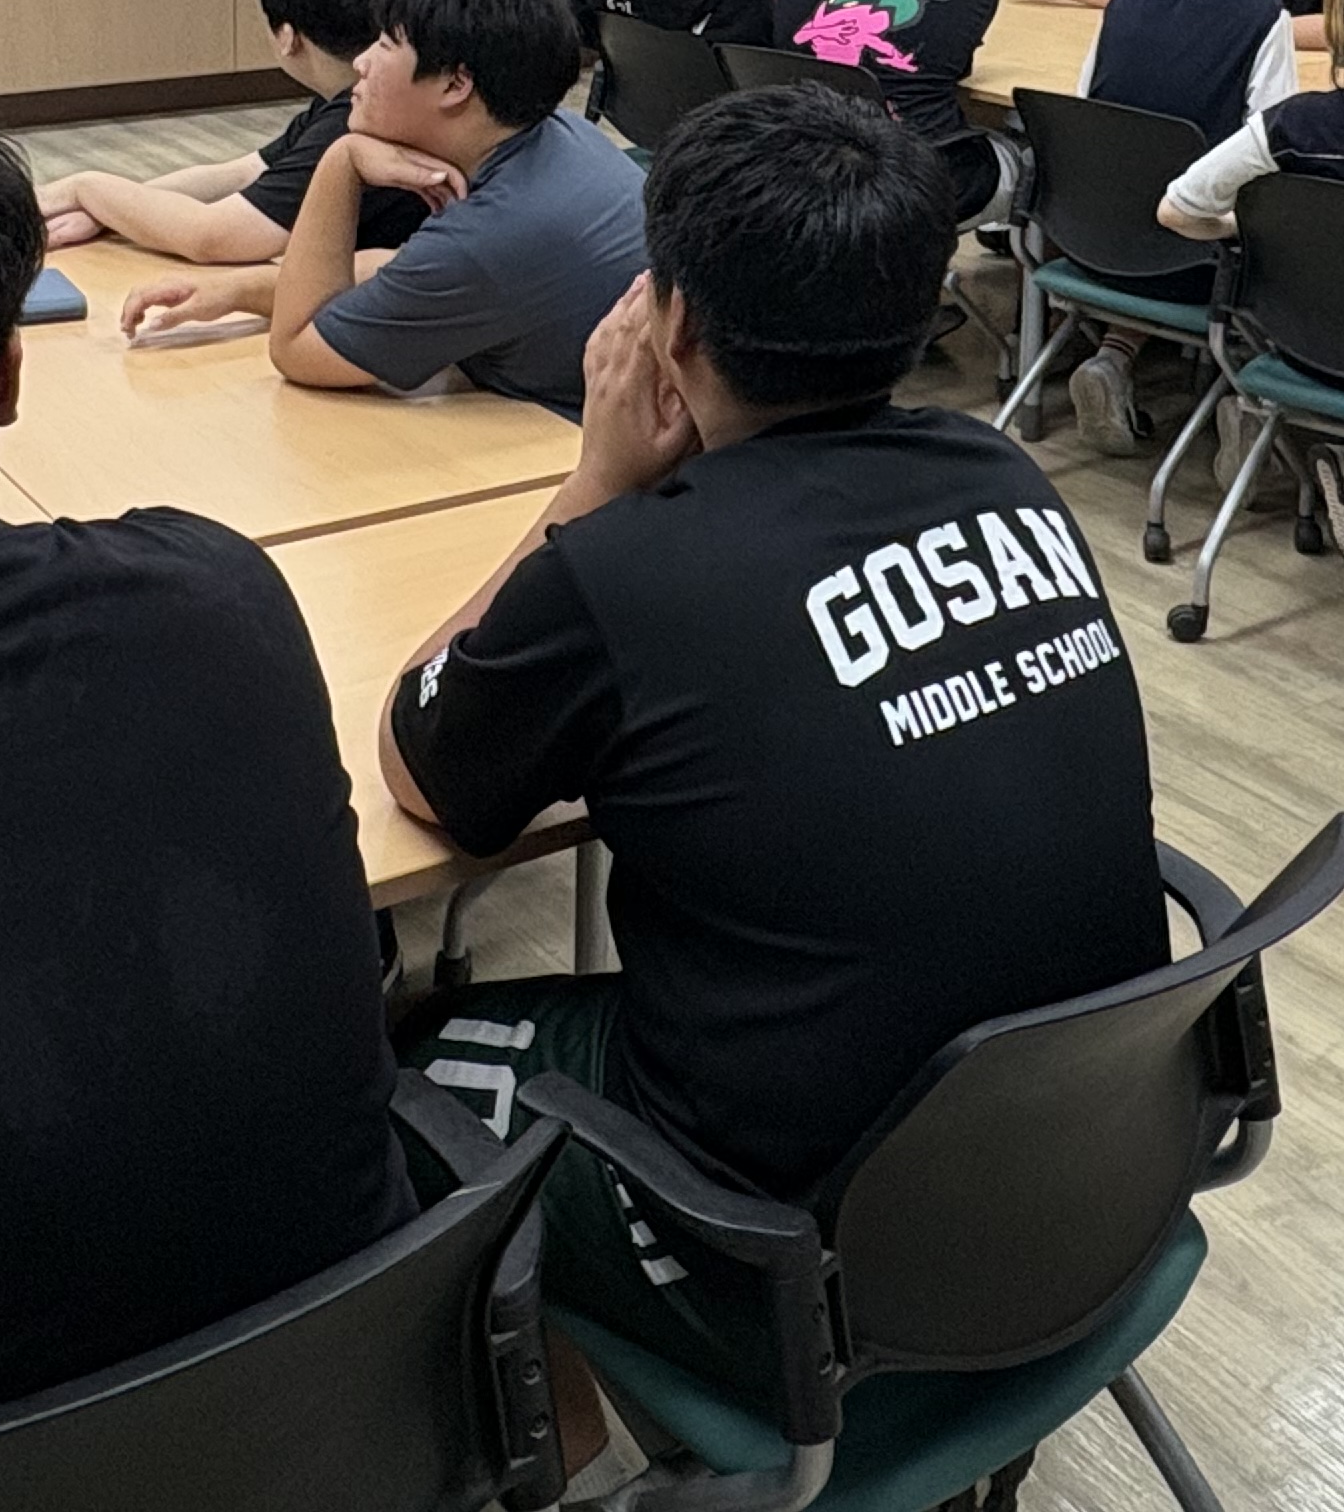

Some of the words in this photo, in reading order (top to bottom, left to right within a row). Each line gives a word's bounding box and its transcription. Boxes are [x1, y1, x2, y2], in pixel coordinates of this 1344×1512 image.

[806, 508, 1099, 688] GOSAN
[879, 661, 1017, 746] MIDDLE
[1015, 618, 1121, 694] SCHOOL
